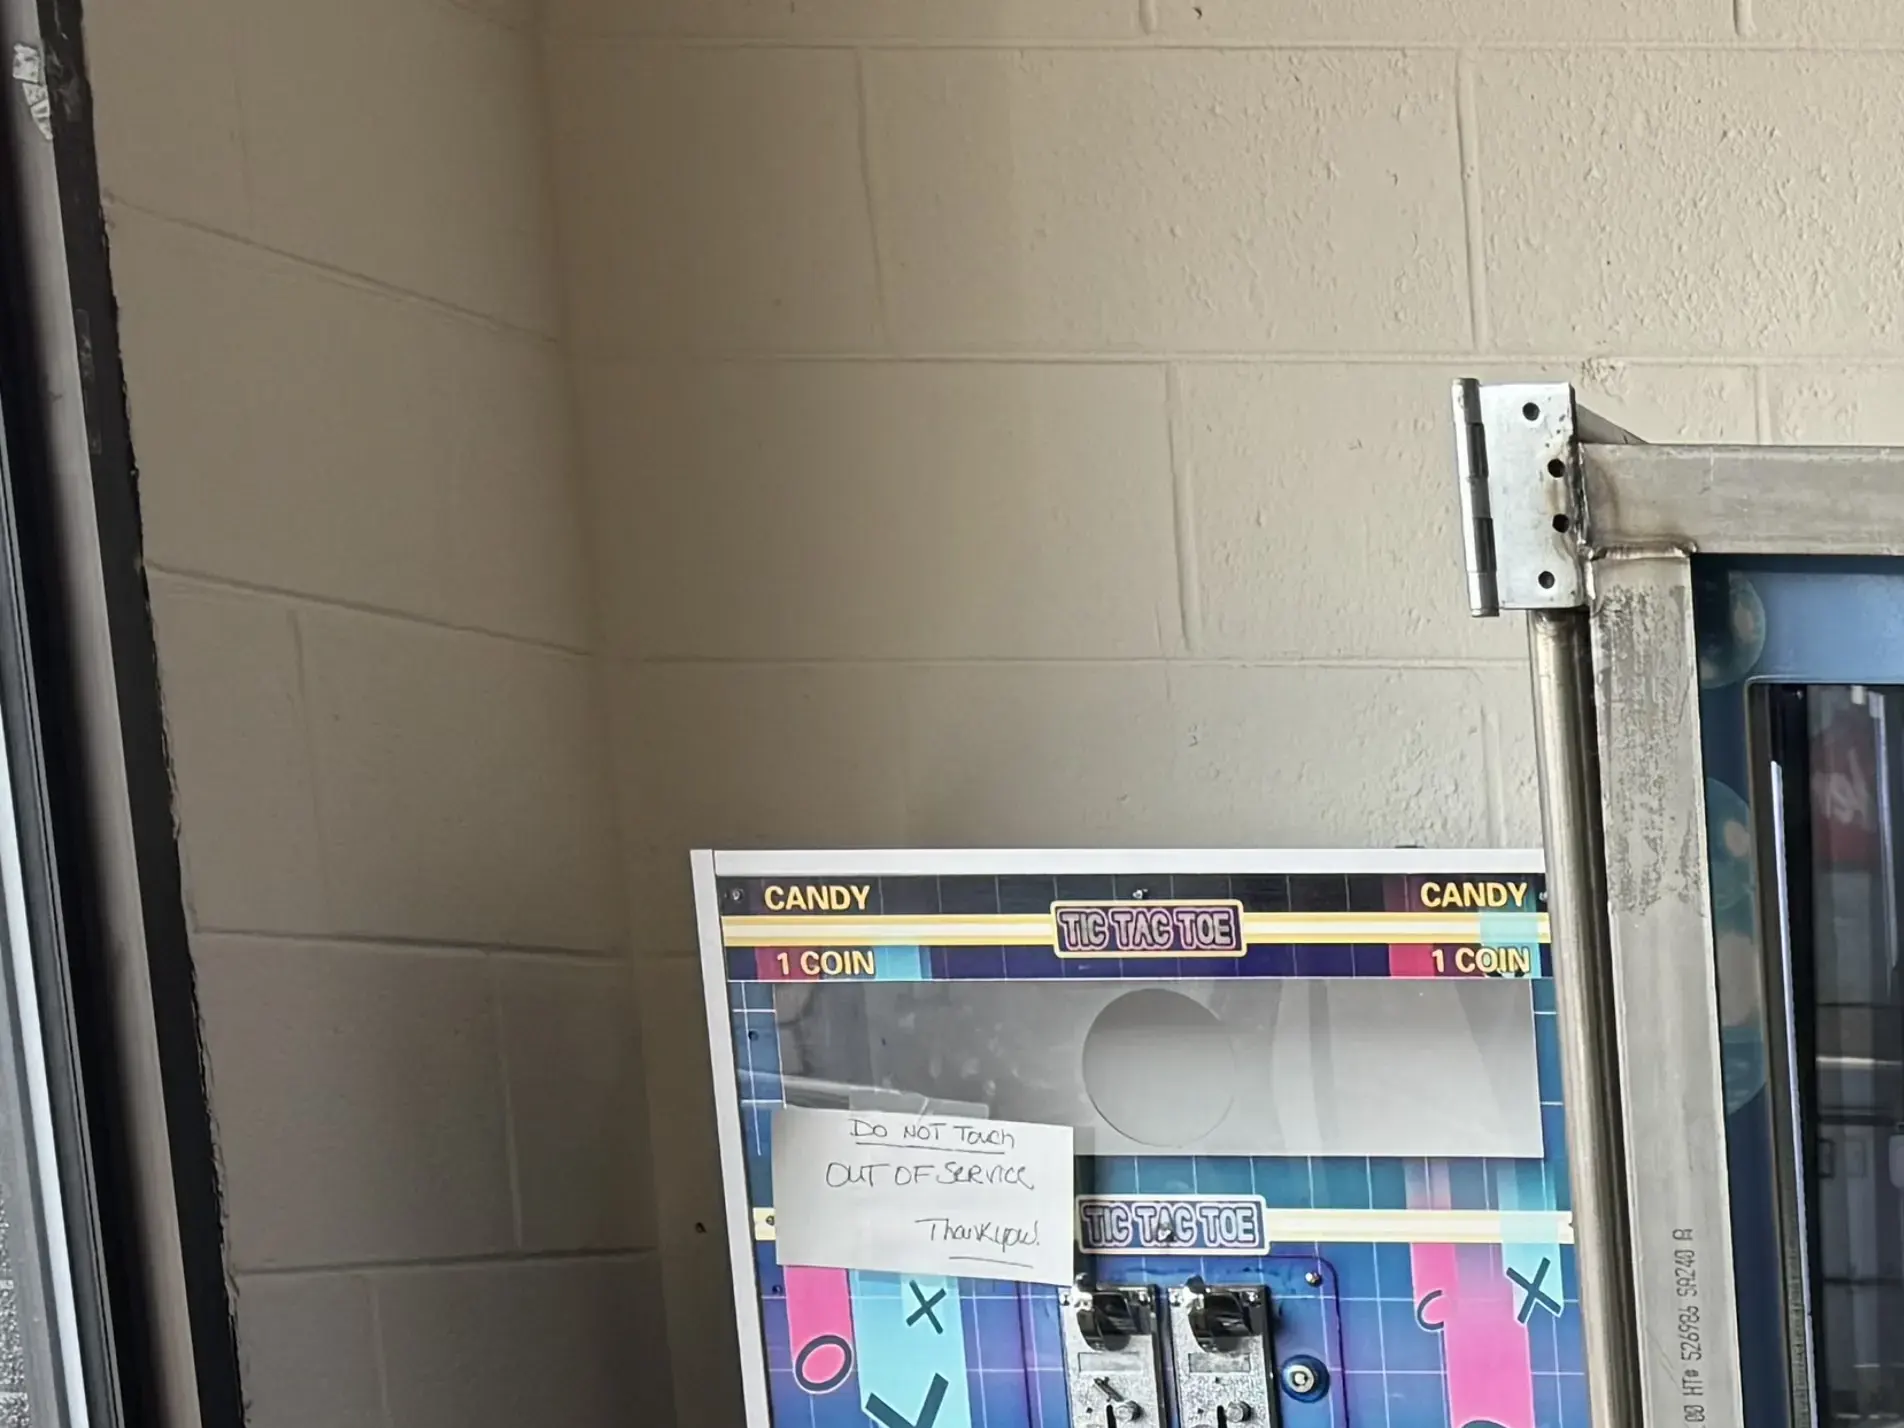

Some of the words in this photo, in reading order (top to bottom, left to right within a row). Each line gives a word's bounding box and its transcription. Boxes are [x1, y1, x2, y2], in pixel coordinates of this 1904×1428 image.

[764, 885, 870, 911] CANDY
[1421, 882, 1528, 908] CANDY
[1061, 910, 1107, 947] TIC
[1114, 909, 1172, 947] TAC
[1175, 910, 1232, 946] TOE
[777, 951, 788, 975] 1
[800, 951, 876, 975] COIN
[1432, 949, 1444, 974] 1
[1455, 947, 1531, 974] COIN
[903, 1123, 946, 1141] NOT
[894, 1165, 935, 1186] OF
[1085, 1211, 1130, 1246] TIC
[1136, 1210, 1196, 1247] TAC
[1199, 1209, 1257, 1244] TOE
